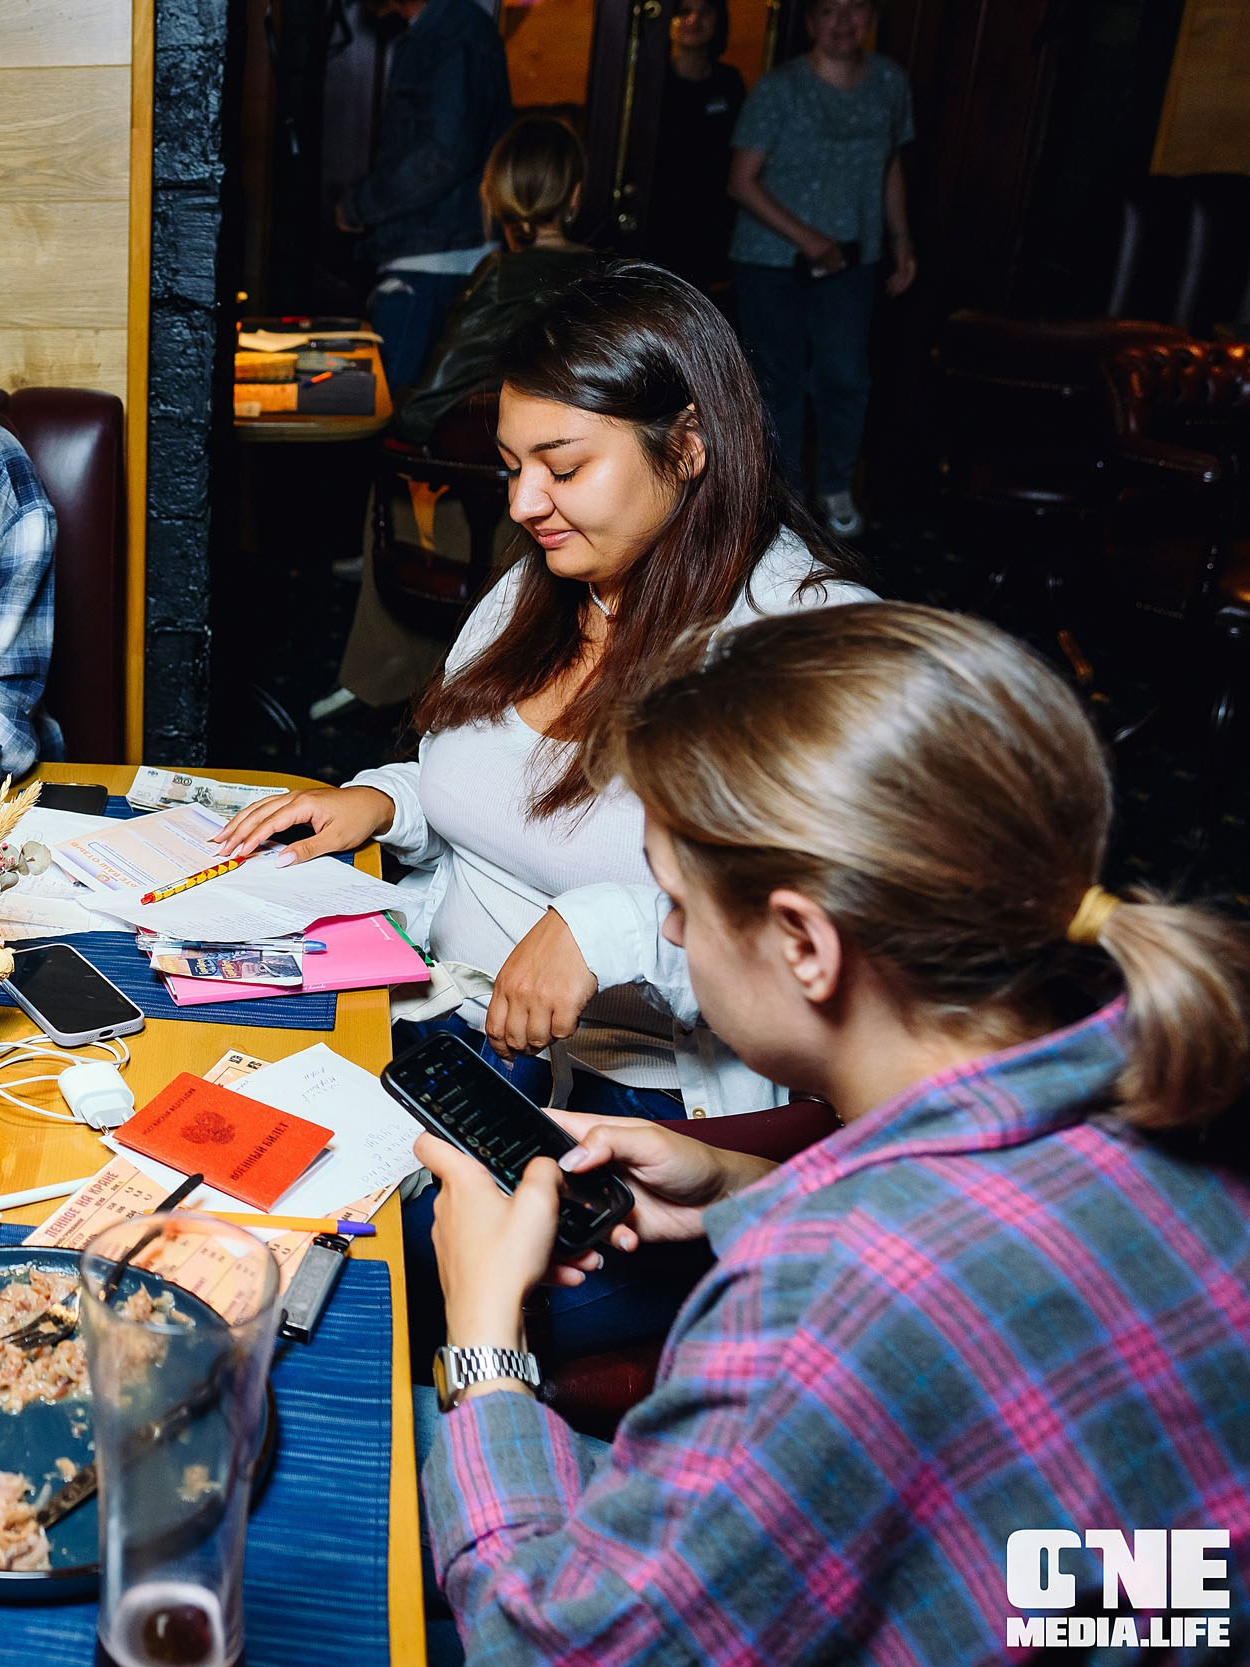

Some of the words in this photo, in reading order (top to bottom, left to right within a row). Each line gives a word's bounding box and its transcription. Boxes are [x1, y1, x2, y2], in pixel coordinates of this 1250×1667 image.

[171, 774, 192, 785] 50
[99, 861, 121, 878] ВАШ
[228, 1143, 267, 1182] ВОЕННЫЙ
[261, 1120, 290, 1149] БИЛЕТ
[44, 1206, 81, 1238] ПЕННОЕ
[75, 1194, 95, 1208] НА
[88, 1169, 119, 1196] КРАНЕ
